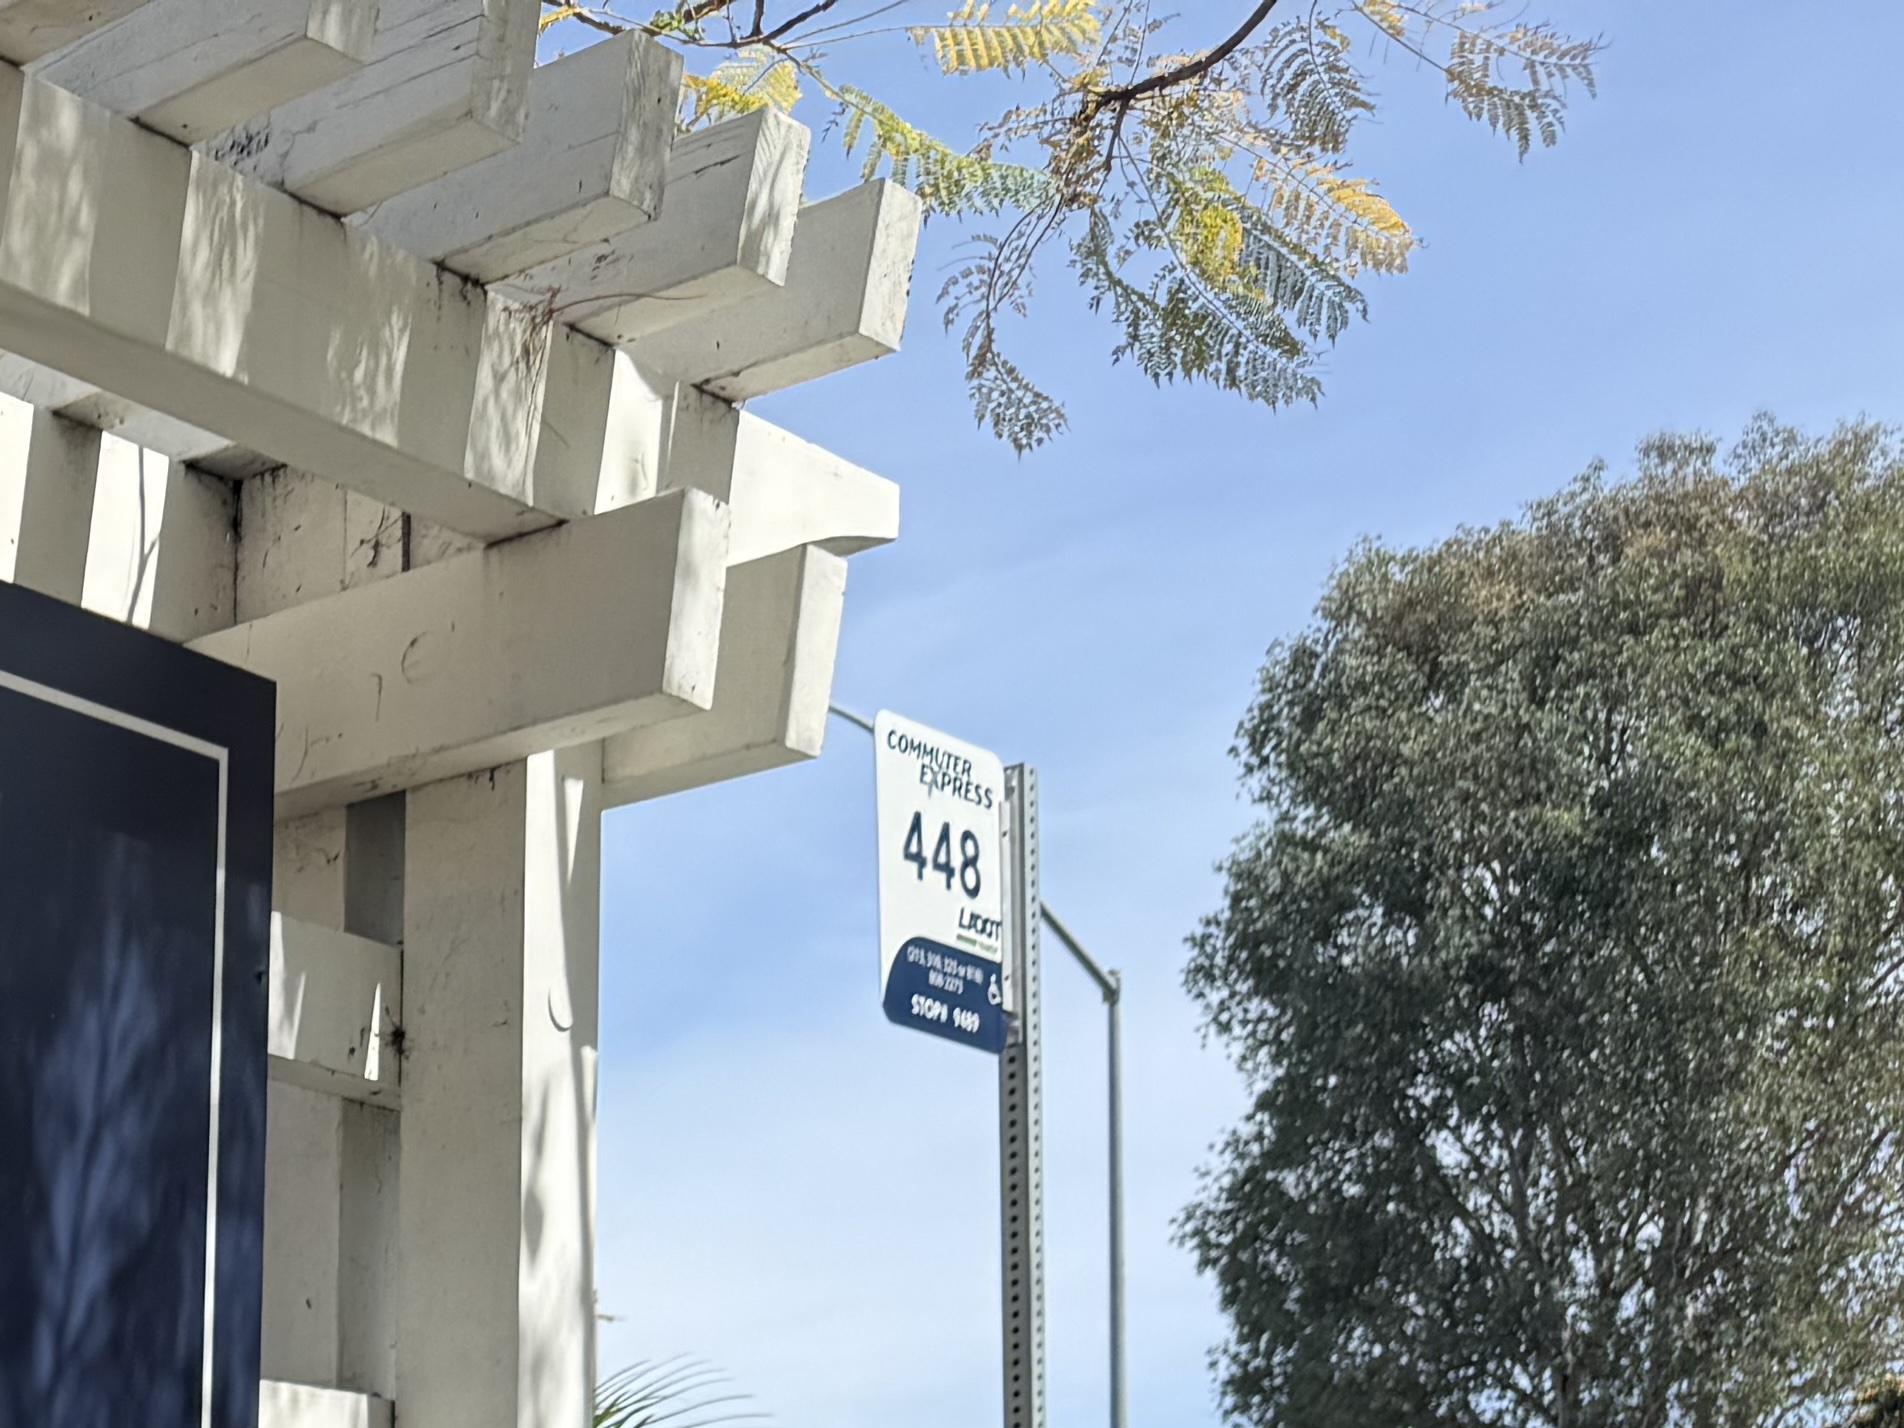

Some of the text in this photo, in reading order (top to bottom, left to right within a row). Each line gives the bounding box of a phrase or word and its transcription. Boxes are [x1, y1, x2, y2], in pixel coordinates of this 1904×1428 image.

[887, 729, 972, 777] COMMUTER
[919, 763, 993, 809] EXPRESS
[903, 810, 981, 899] 448
